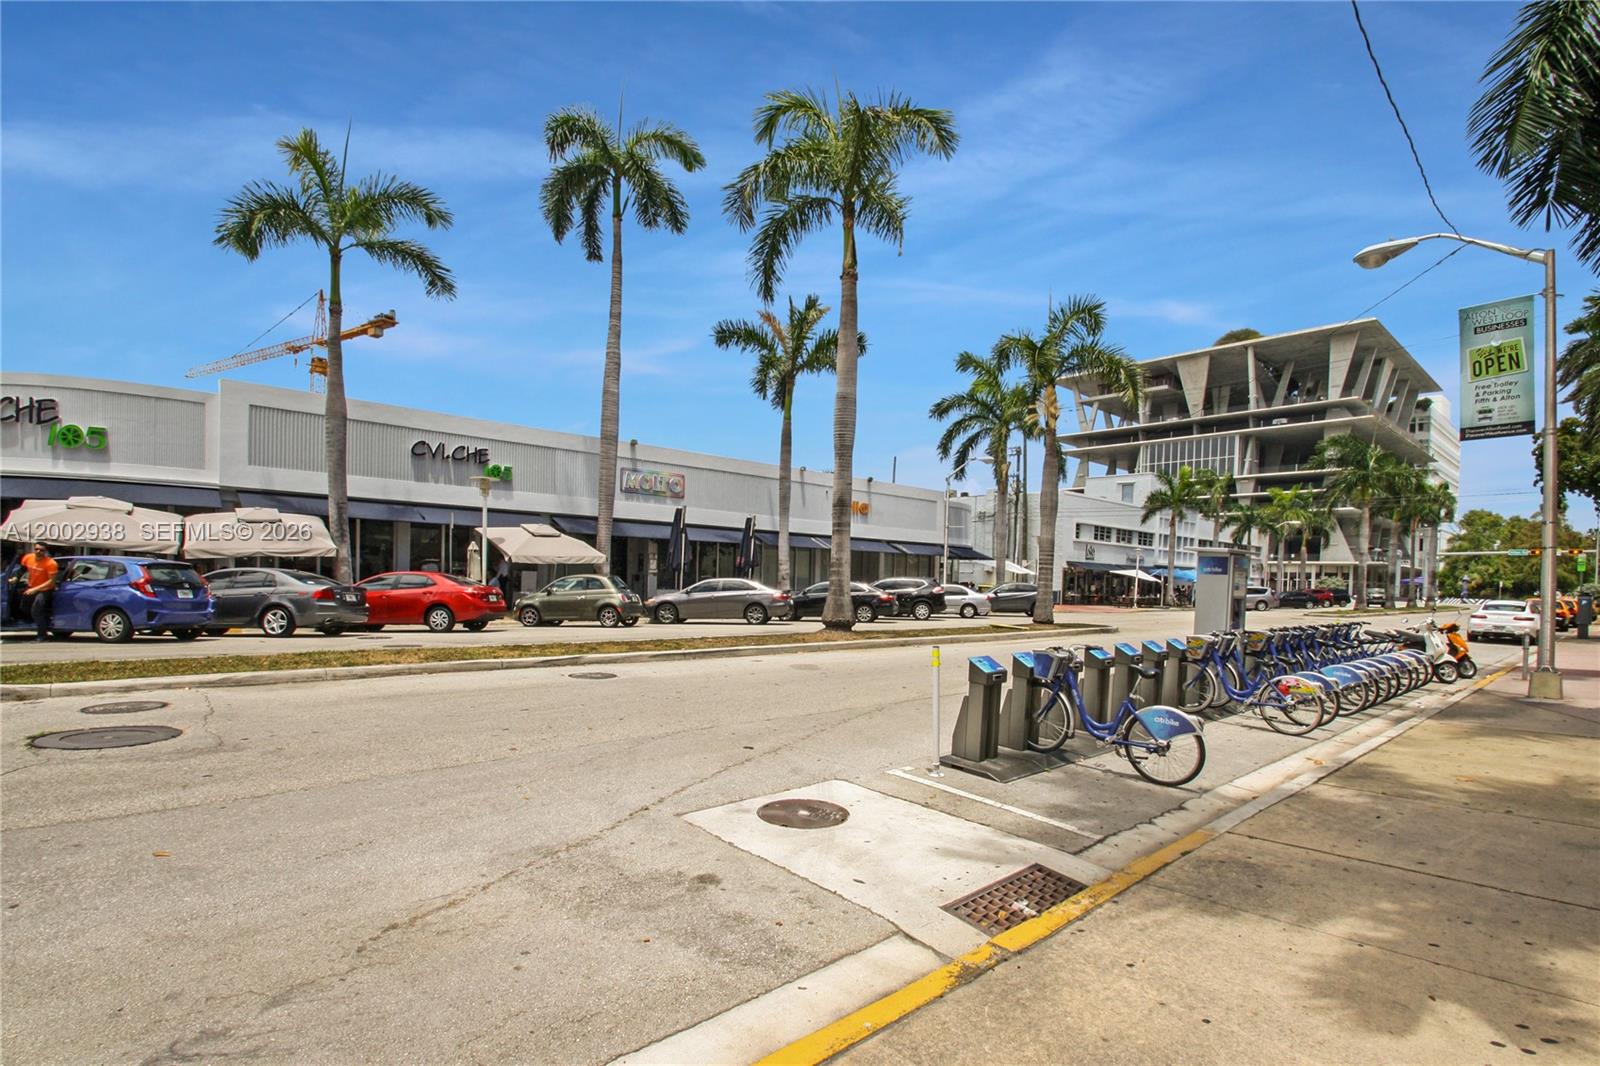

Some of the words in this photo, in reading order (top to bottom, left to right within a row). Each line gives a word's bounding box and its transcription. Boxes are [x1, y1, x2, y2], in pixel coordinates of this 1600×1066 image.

[1472, 315, 1498, 326] WEST
[1502, 310, 1528, 320] LOOP
[1476, 320, 1525, 334] BUSINESSES
[1472, 352, 1521, 377] OPEN
[1494, 380, 1519, 388] Trolley
[1474, 397, 1490, 405] Fifth
[1500, 394, 1521, 402] Alton
[1482, 389, 1512, 397] Parking
[0, 396, 60, 425] CHE
[48, 422, 108, 449] 105
[623, 471, 682, 494] MOLTO
